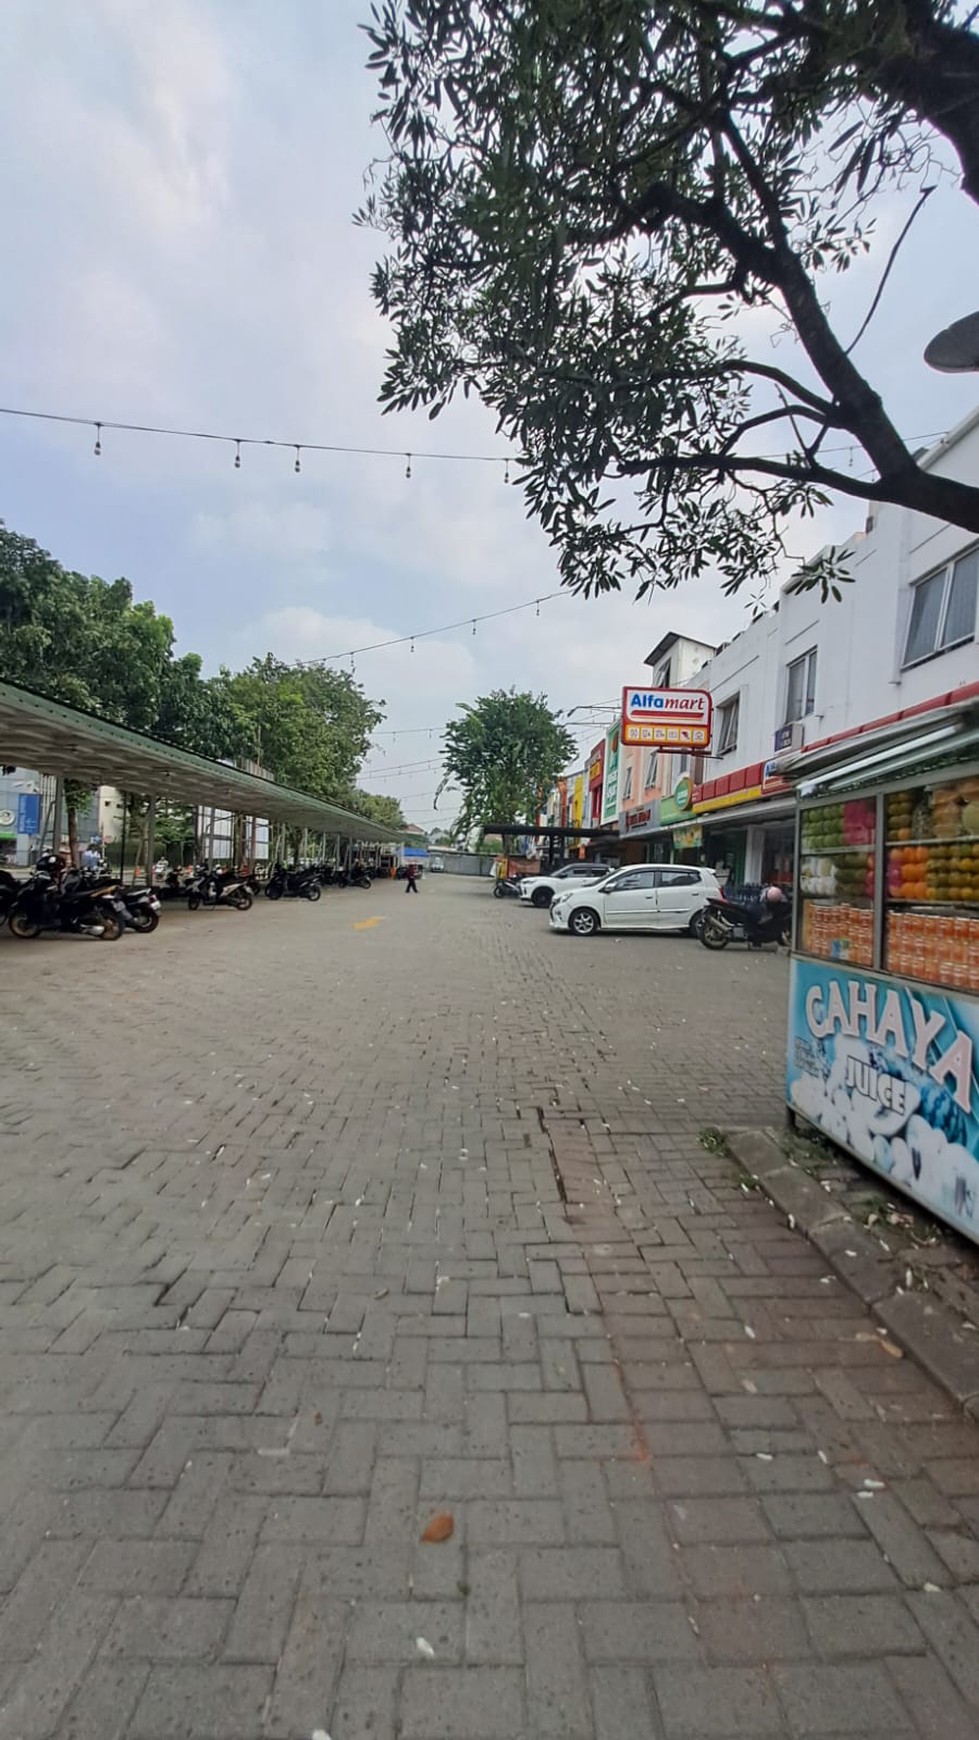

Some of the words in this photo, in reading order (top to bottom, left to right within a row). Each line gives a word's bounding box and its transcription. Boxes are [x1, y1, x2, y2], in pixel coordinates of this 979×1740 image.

[630, 694, 705, 710] Alfamart
[806, 980, 973, 1113] CAHAYA
[846, 1055, 906, 1115] JUICE
